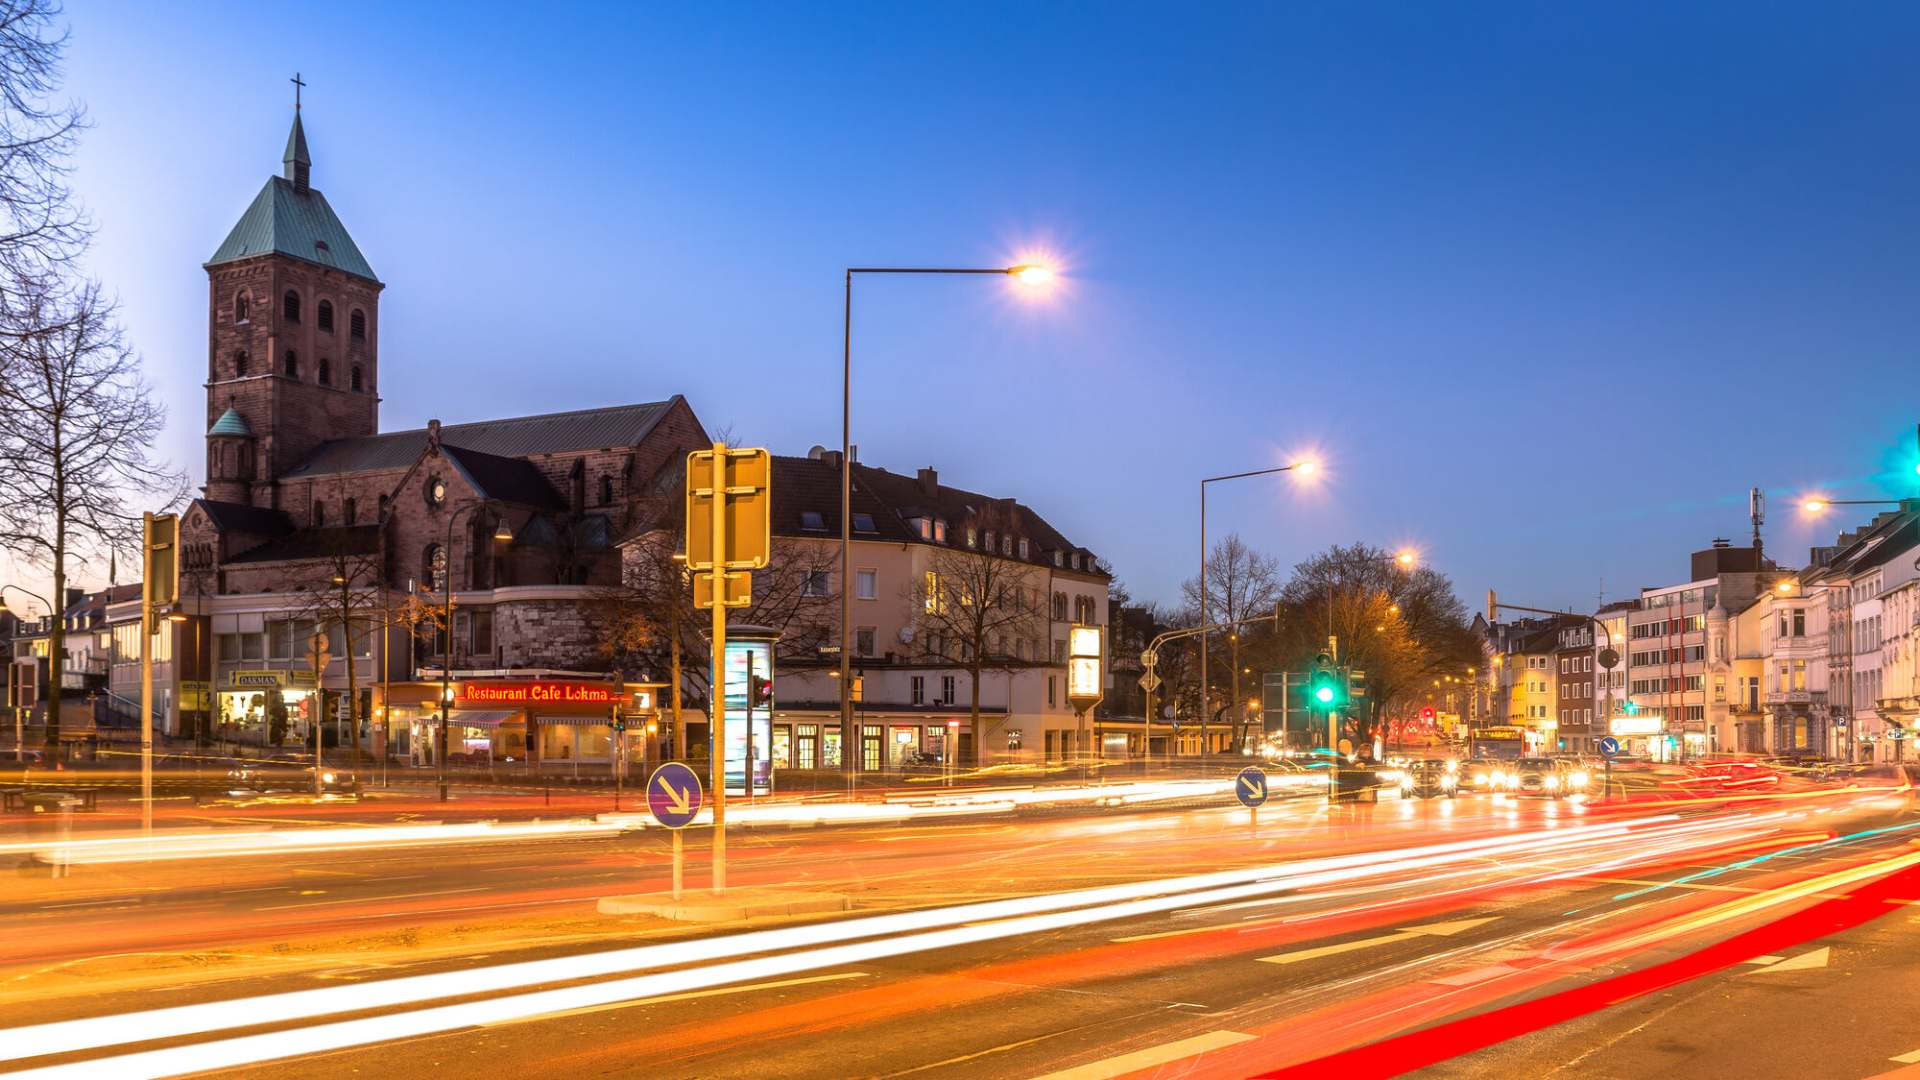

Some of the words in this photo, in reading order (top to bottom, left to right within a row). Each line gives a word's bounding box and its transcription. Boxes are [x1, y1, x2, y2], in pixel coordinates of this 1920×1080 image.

[467, 685, 527, 700] Restaurant
[531, 686, 561, 700] Cafe
[565, 686, 608, 701] Lokma
[1839, 717, 1845, 725] P
